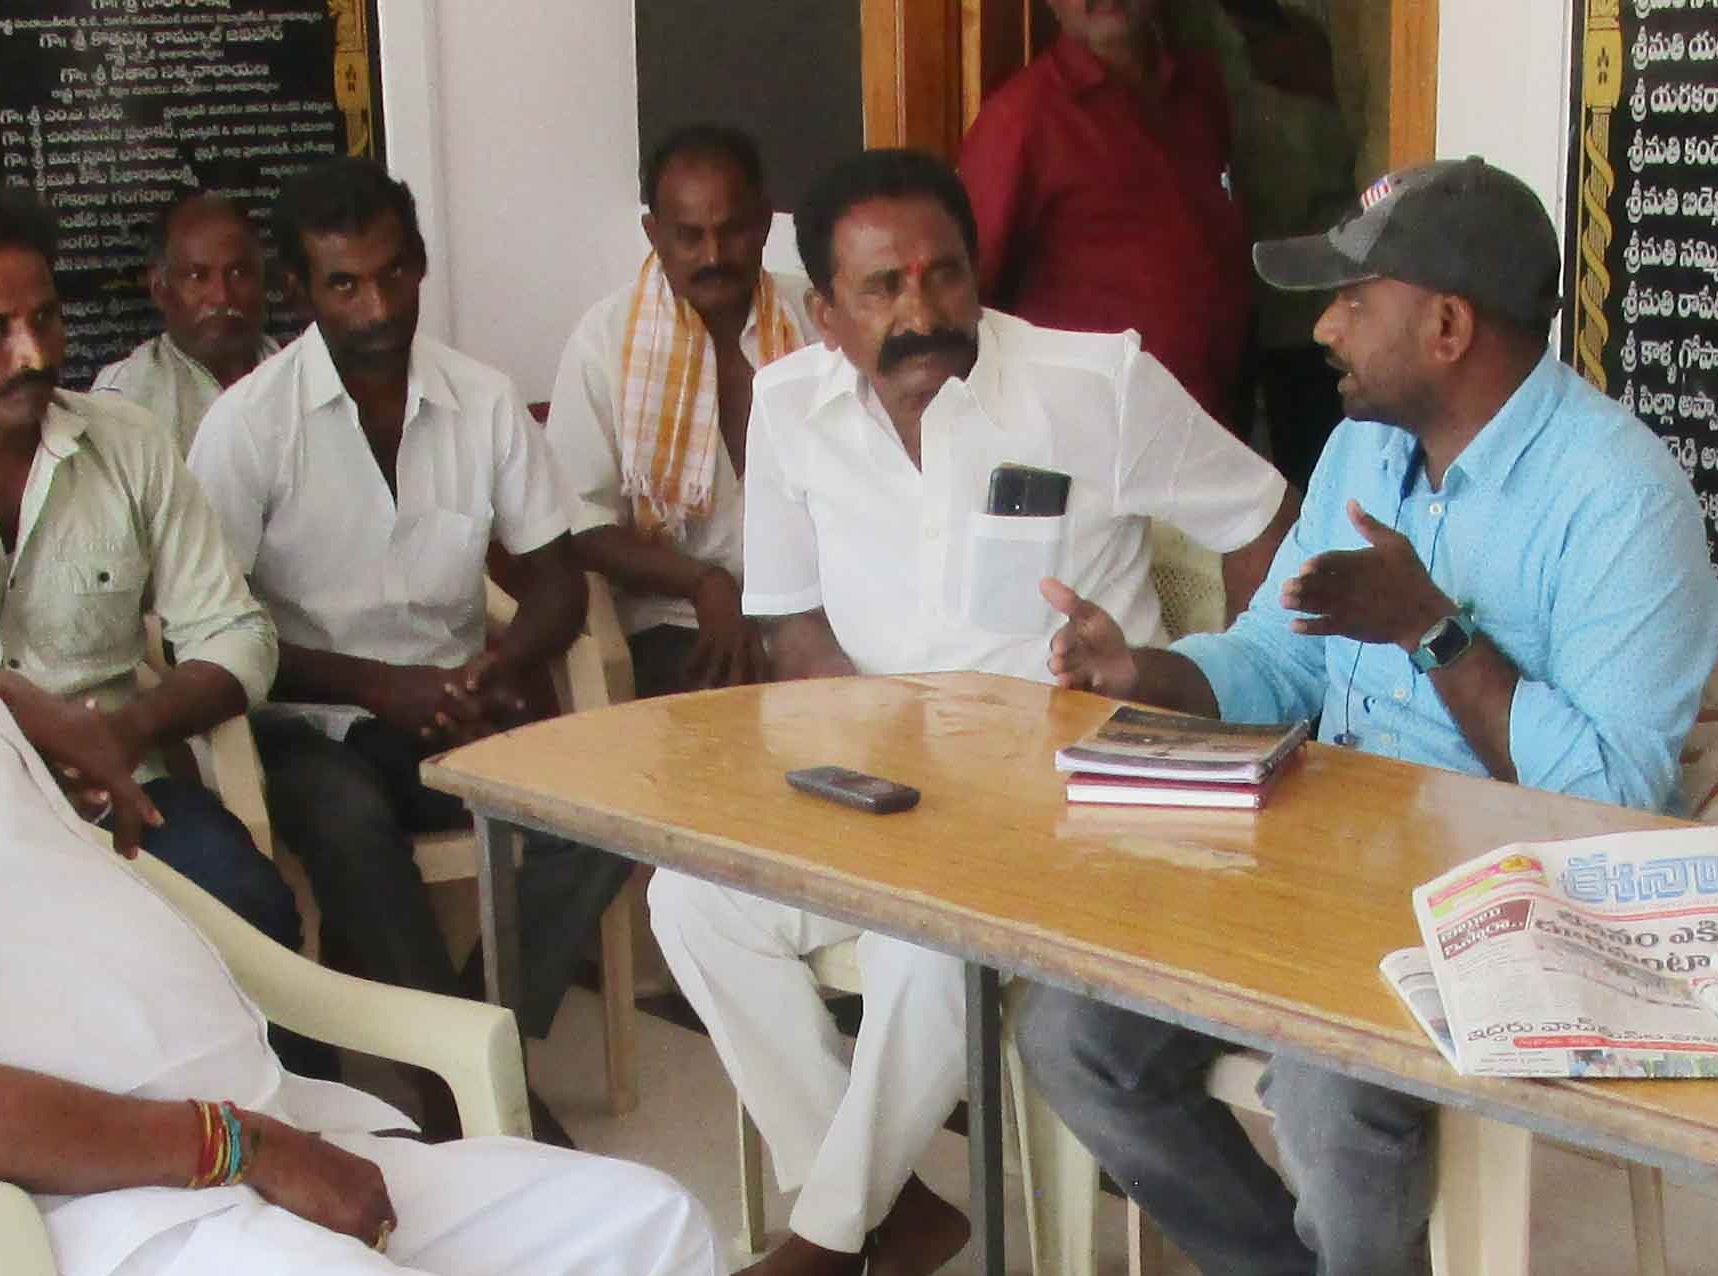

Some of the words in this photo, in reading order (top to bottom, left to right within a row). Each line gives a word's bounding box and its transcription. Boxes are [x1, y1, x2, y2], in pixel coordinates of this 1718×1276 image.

[1631, 26, 1685, 70] శ్రీమతి
[1630, 77, 1647, 122] శ్రీ
[1627, 129, 1680, 173] శ్రీమతి
[1625, 179, 1678, 223] శ్రీమతి
[1623, 230, 1677, 274] శ్రీమతి
[1621, 280, 1674, 324] శ్రీమతి
[1621, 329, 1636, 373] శ్రీ
